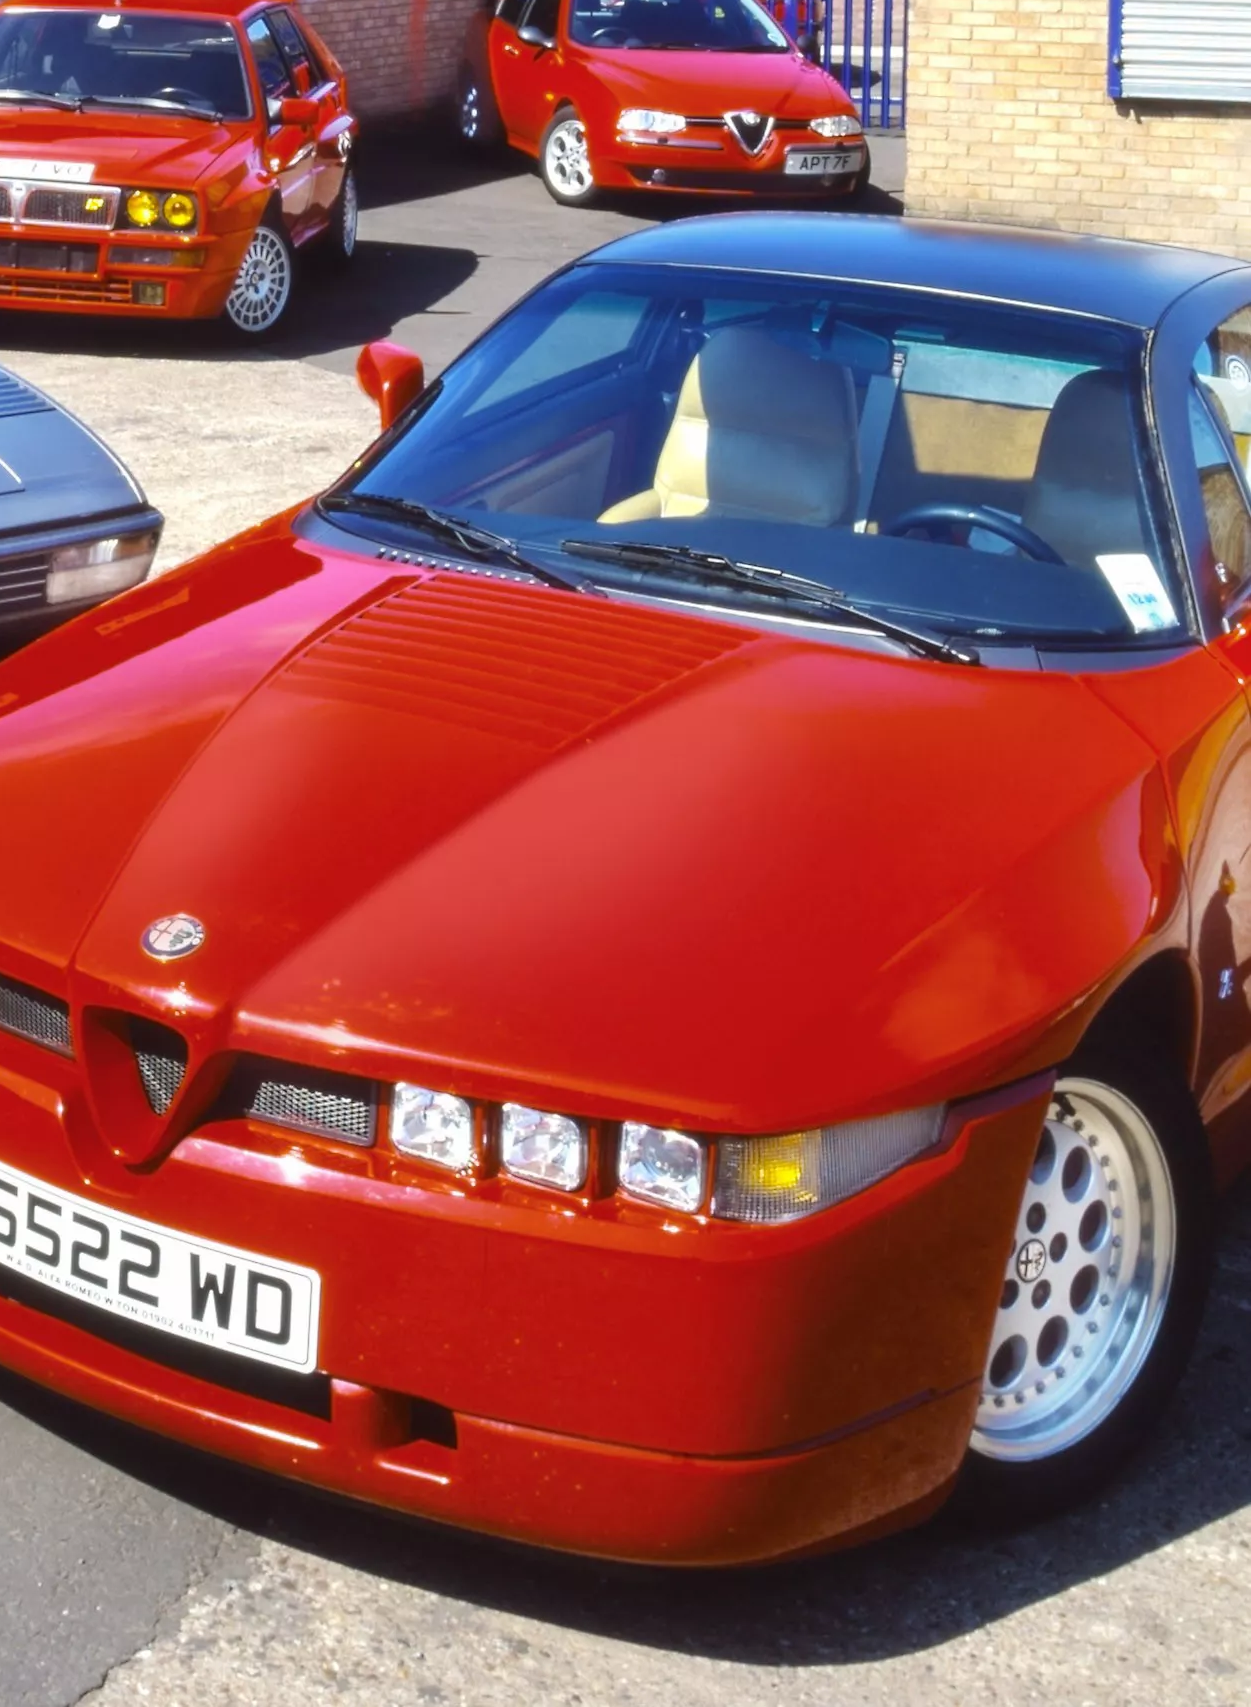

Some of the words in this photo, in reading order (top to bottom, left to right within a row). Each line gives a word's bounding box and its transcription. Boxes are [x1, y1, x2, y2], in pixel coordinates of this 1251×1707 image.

[799, 156, 831, 171] APT
[65, 1280, 101, 1302] ROMEO
[190, 1252, 292, 1346] WD
